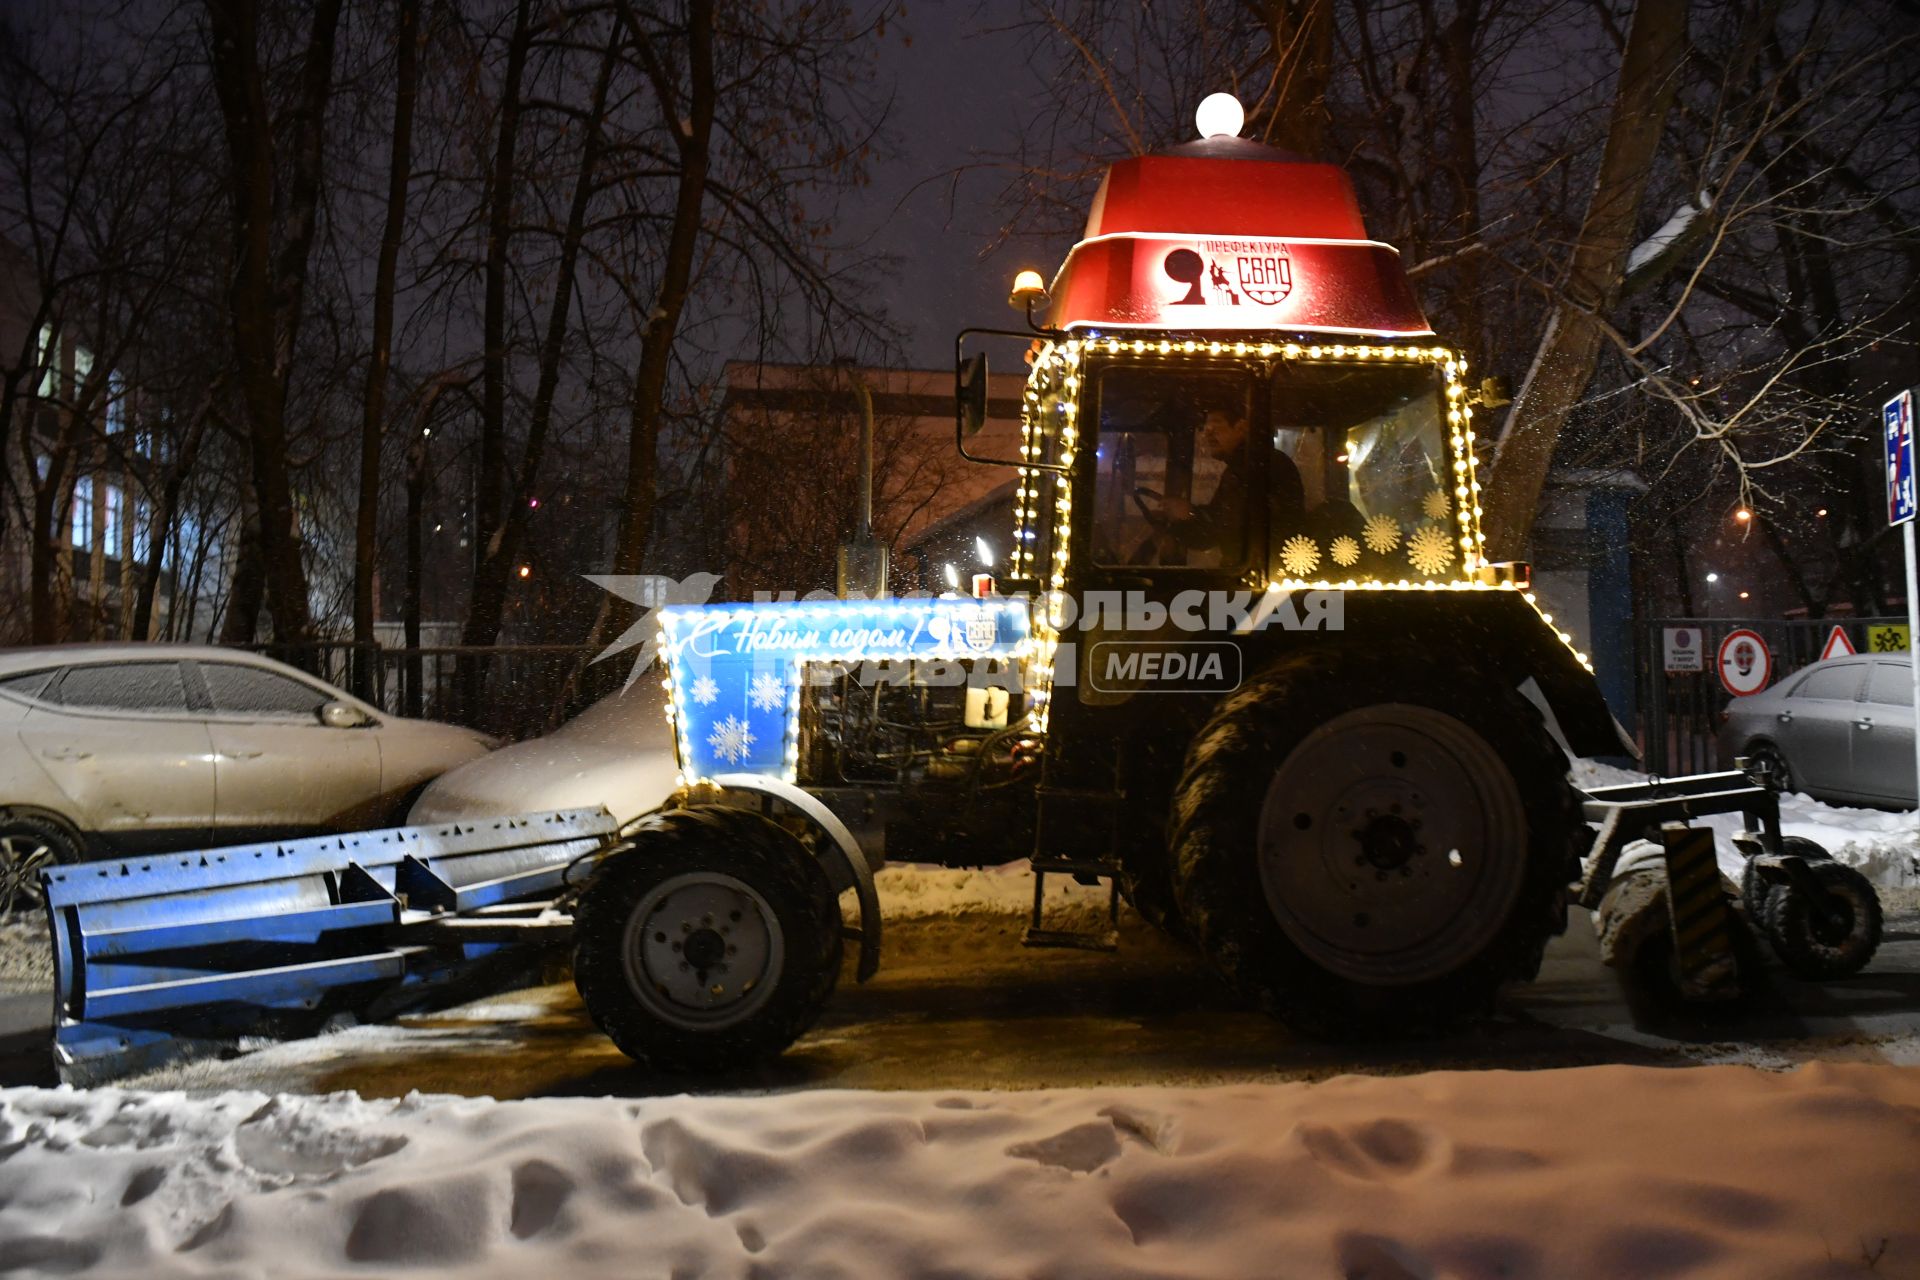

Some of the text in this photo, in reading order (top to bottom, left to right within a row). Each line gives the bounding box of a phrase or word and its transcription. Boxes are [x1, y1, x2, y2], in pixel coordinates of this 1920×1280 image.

[1206, 241, 1289, 255] ПРЕФЕКТУРА
[1237, 257, 1291, 285] СВАО
[680, 616, 924, 657] С Новым годом!
